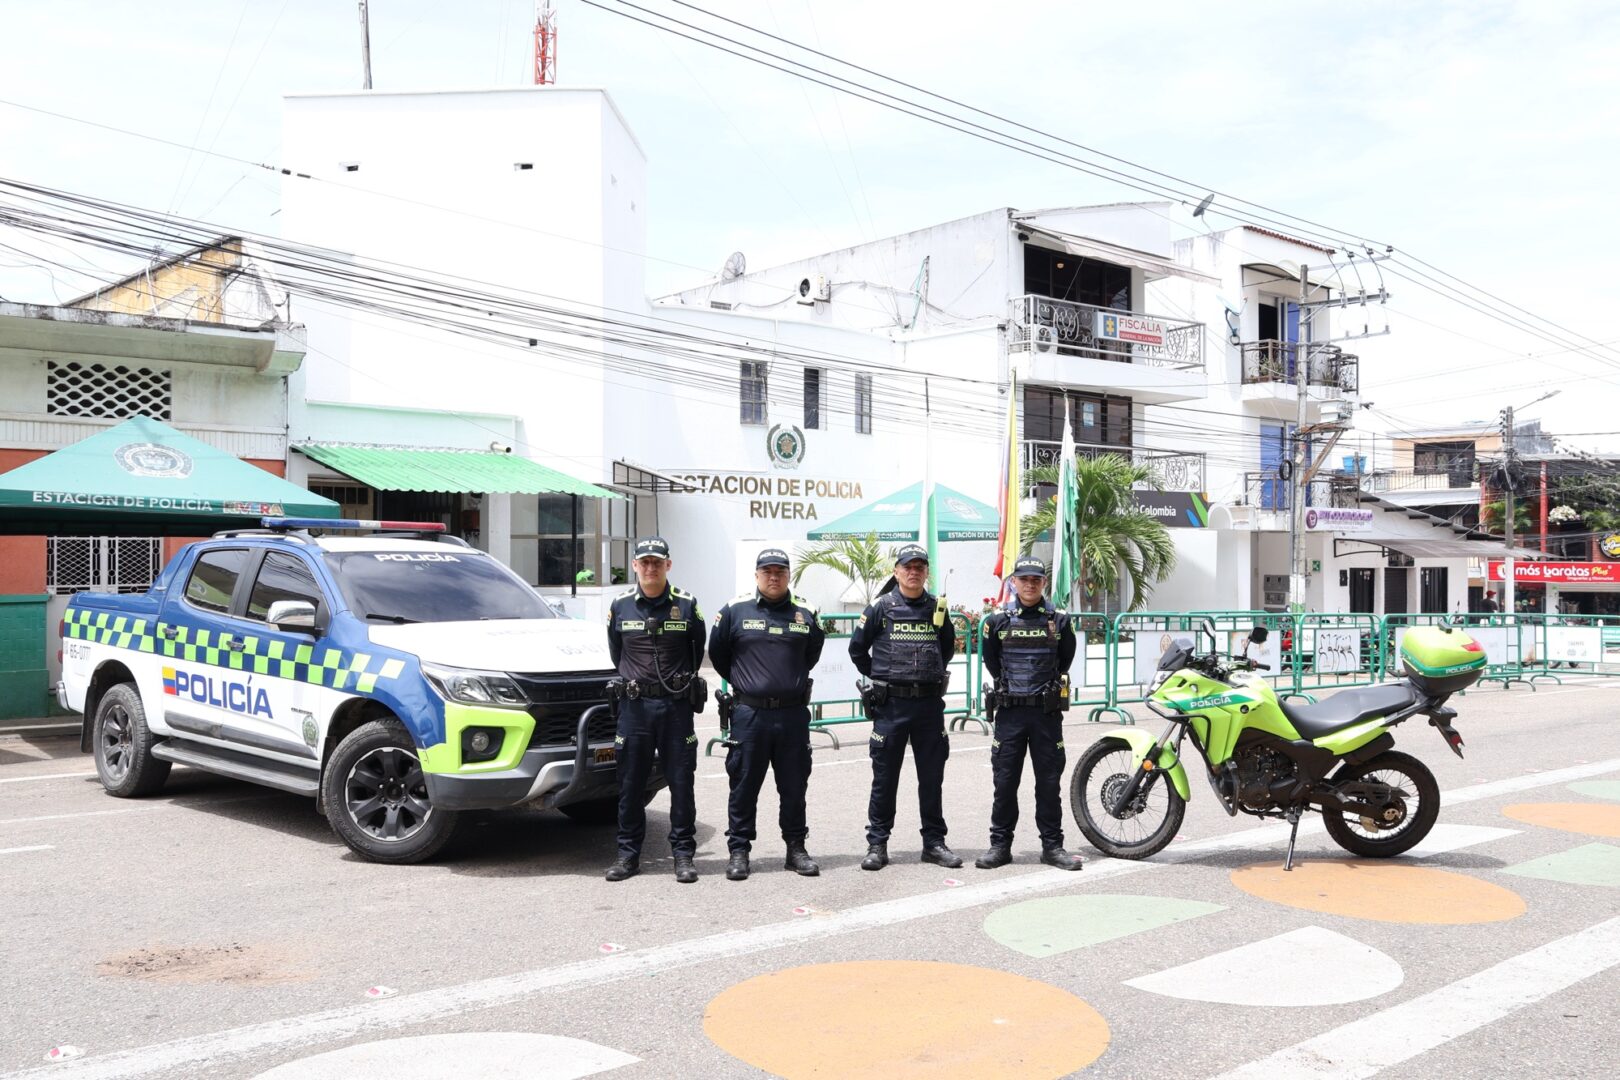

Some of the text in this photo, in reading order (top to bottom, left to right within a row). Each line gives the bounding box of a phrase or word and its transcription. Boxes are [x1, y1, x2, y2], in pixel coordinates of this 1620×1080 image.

[669, 474, 863, 499] ESTACION DE POLICIA
[122, 496, 144, 508] DE
[222, 500, 285, 516] RIVERA
[749, 499, 818, 520] RIVERA
[1139, 504, 1177, 517] Colombia
[374, 552, 461, 563] POLICÍA
[1515, 564, 1541, 576] más
[1591, 566, 1608, 576] Plus
[893, 622, 935, 633] POLICÍA
[1011, 629, 1047, 637] POLICÍA
[1446, 664, 1473, 675] POLICÍA
[175, 674, 274, 720] POLICÍA
[1190, 696, 1232, 709] POLICÍA
